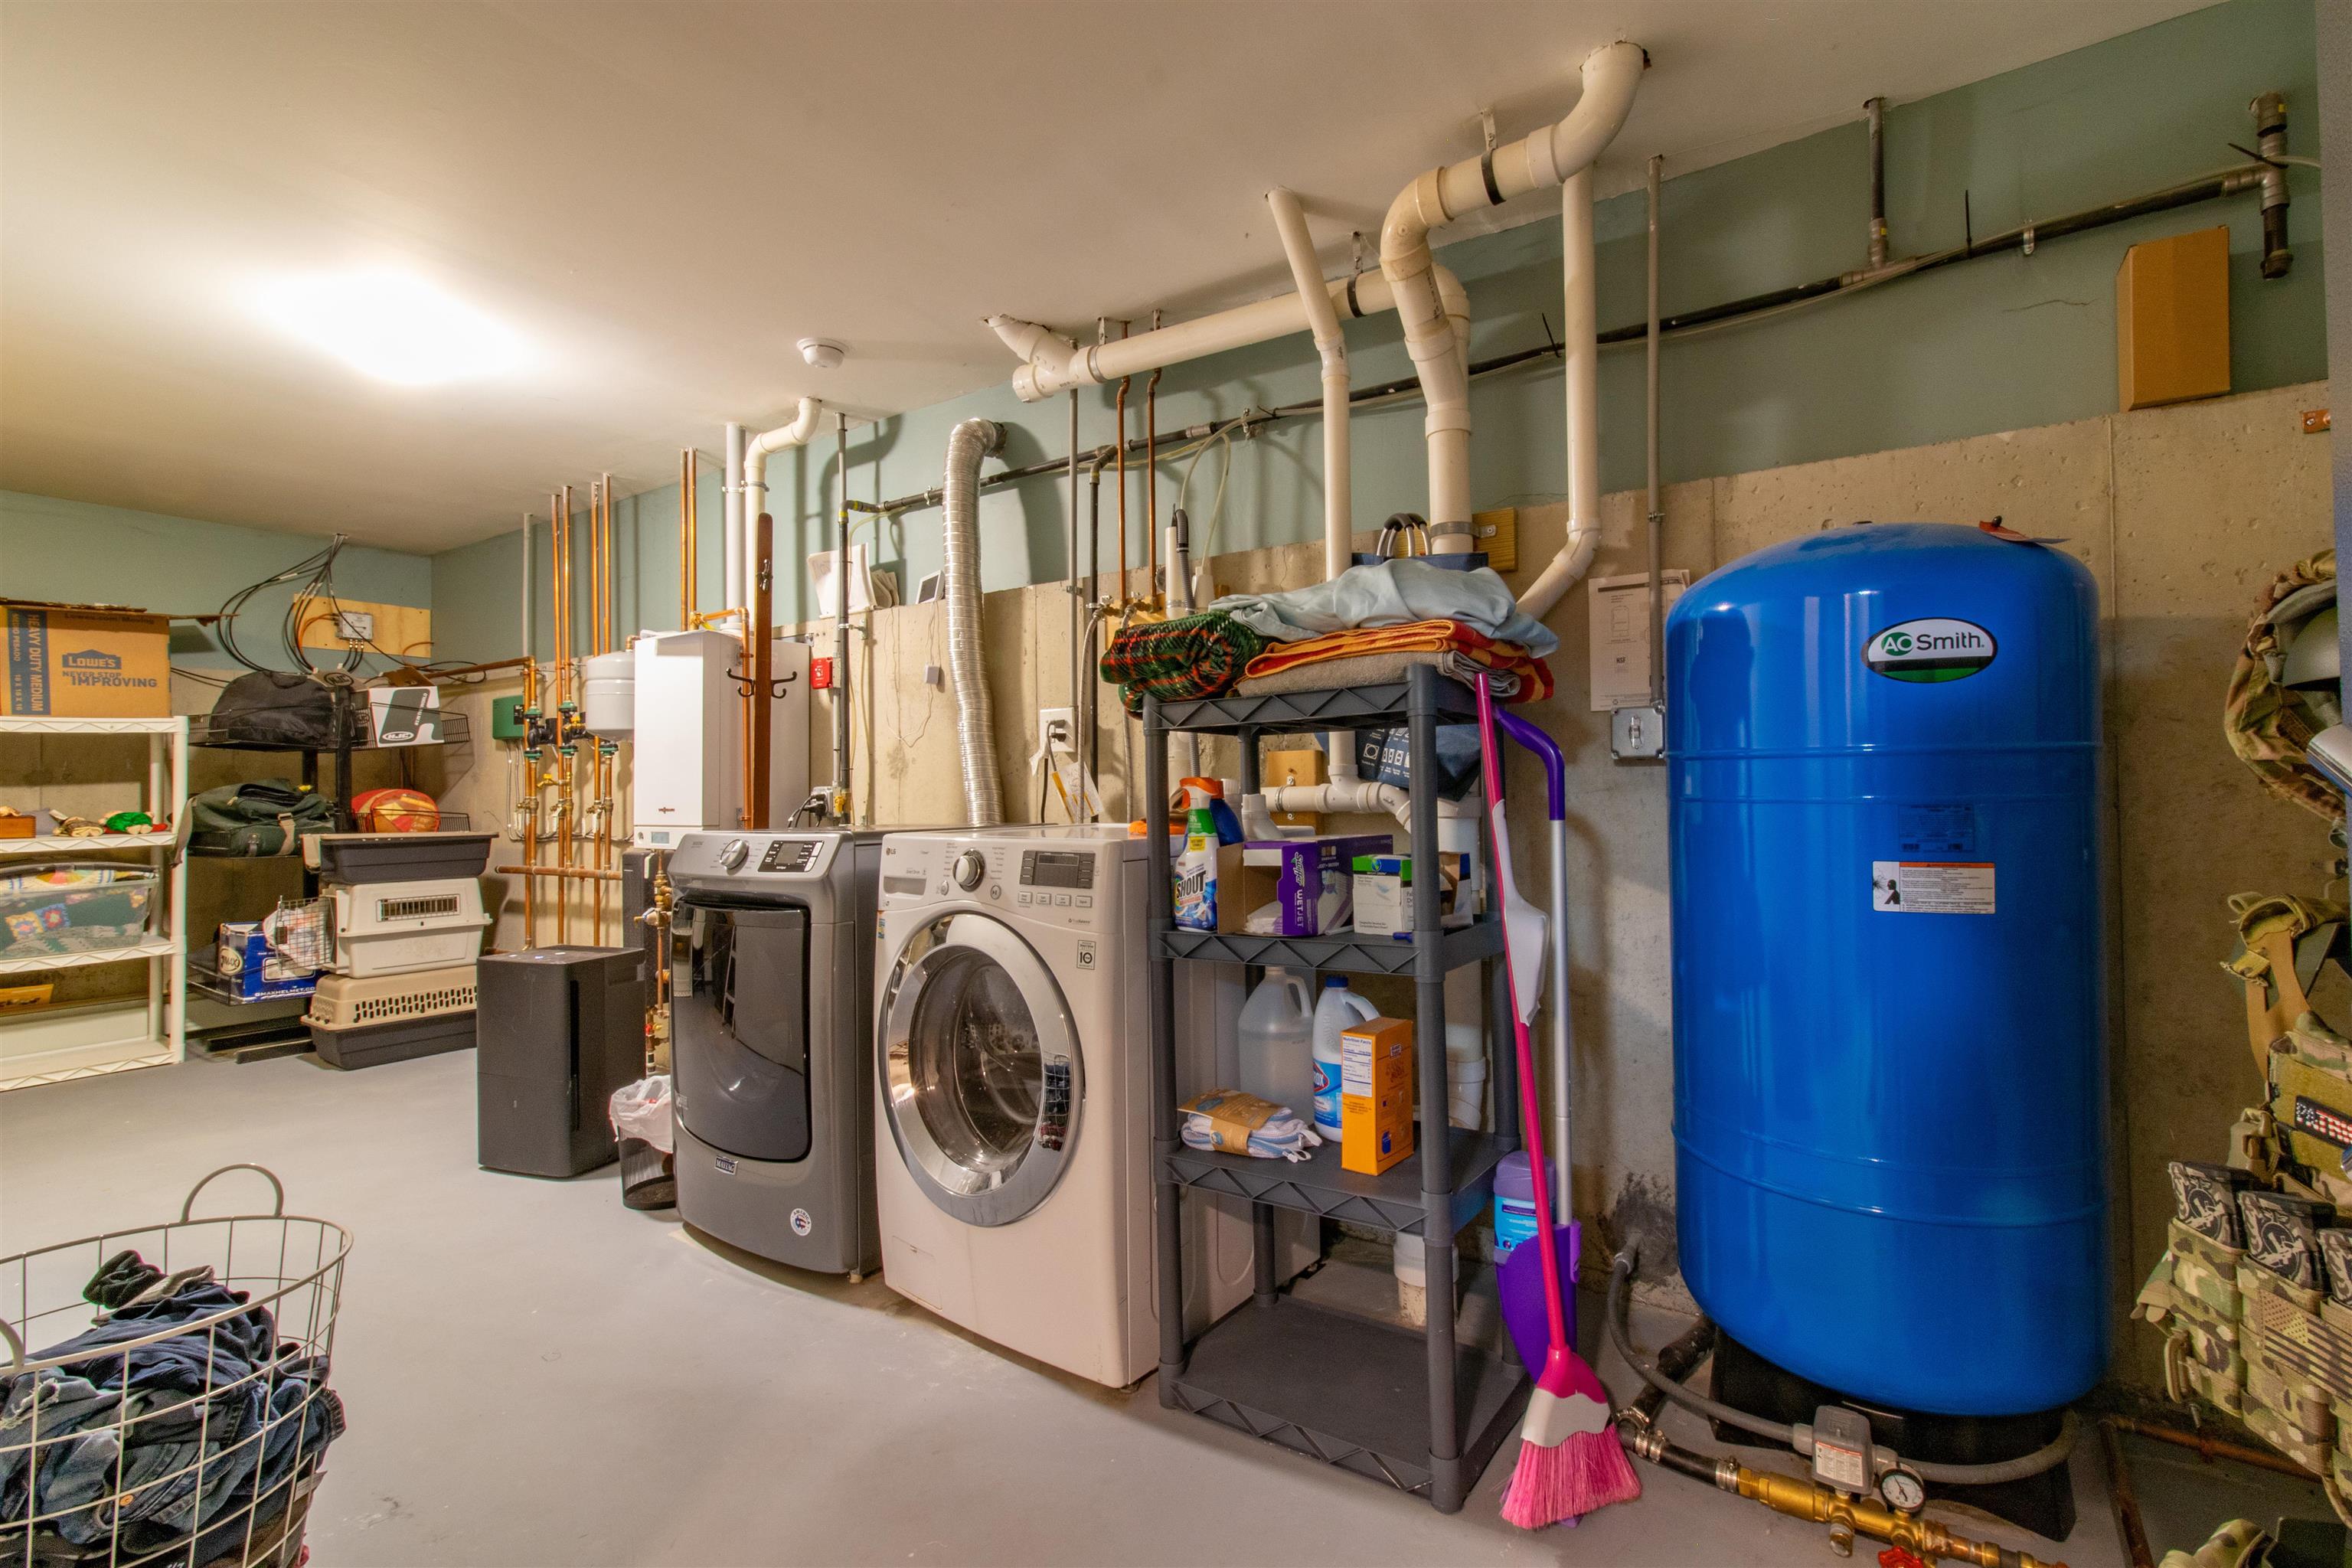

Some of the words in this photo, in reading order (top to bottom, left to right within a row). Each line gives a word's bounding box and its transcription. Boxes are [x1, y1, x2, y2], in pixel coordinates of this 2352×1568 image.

[28, 614, 41, 645] HEAVY
[13, 635, 21, 662] PESADO
[1883, 635, 1914, 652] AO
[1916, 632, 1981, 651] Smith
[29, 648, 42, 672] DUTY
[68, 655, 116, 668] LOWE'S
[31, 674, 44, 711] MEDIUM
[71, 676, 158, 688] IMPROVING
[1294, 851, 1305, 887] Swiffer
[1177, 870, 1207, 899] SHOUT
[1080, 952, 1093, 964] 10
[717, 1158, 735, 1172] MAYTAG
